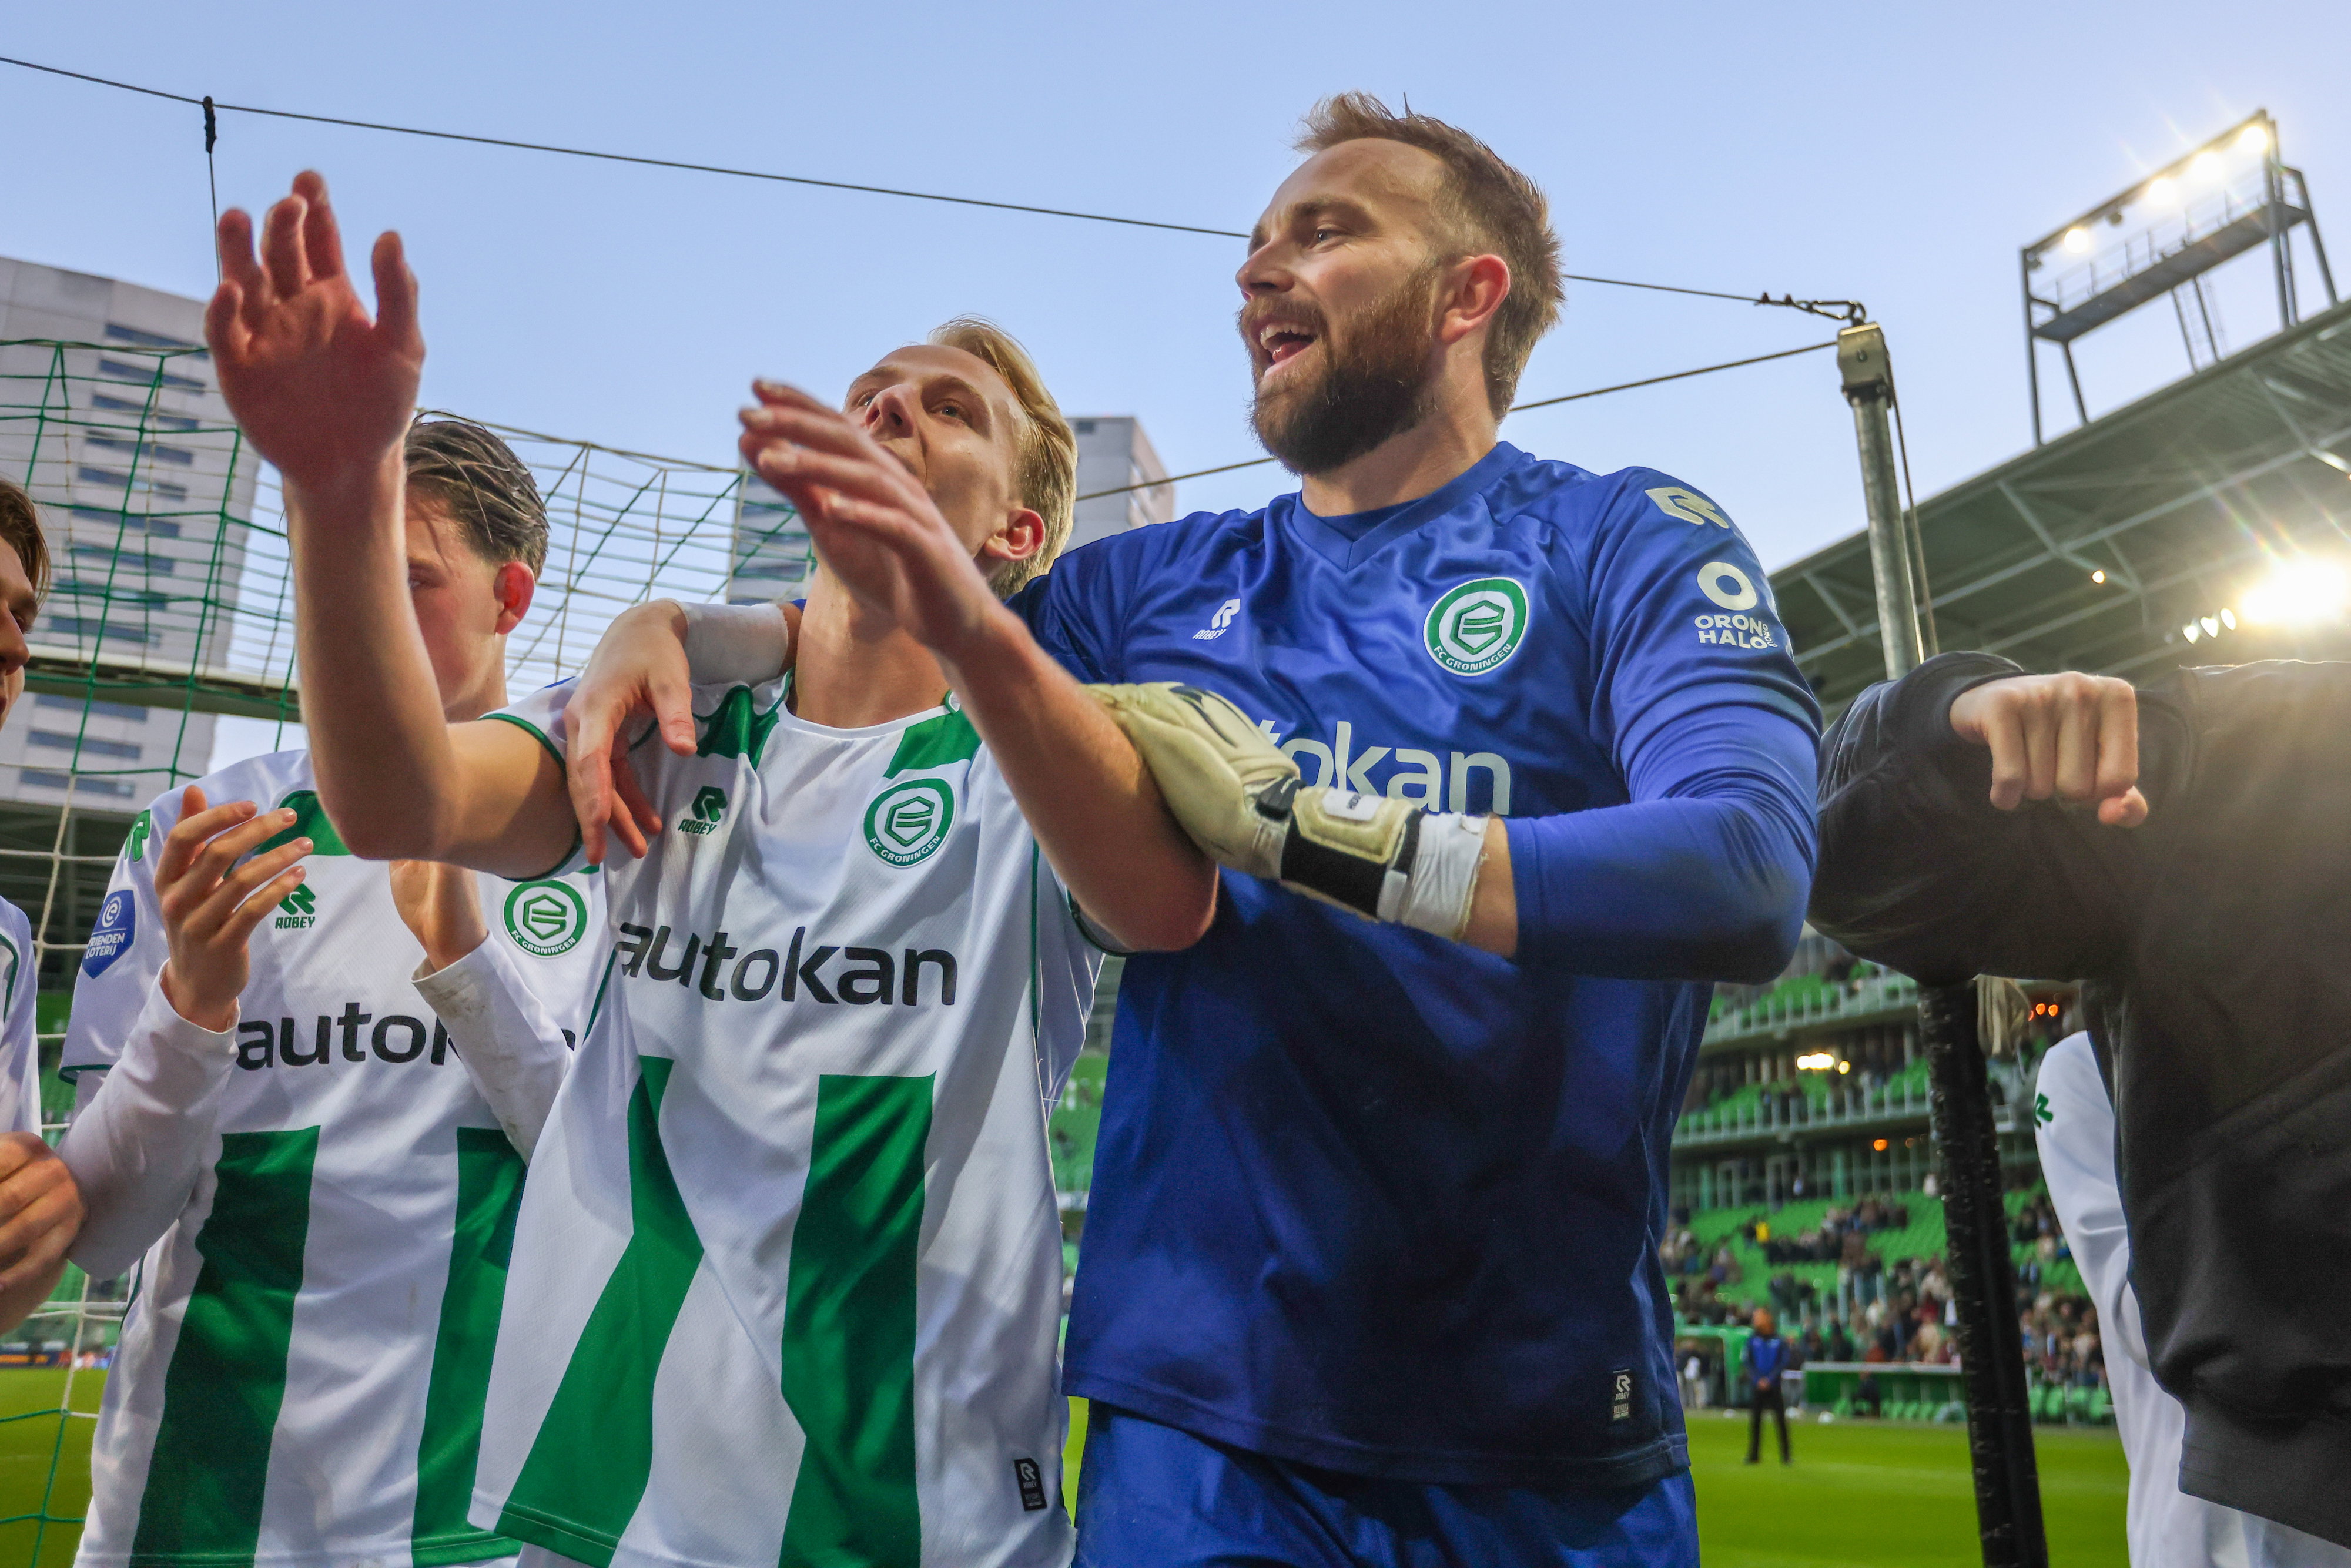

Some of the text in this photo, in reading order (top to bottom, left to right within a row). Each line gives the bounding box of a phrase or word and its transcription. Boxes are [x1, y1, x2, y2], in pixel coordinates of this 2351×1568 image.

[1191, 628, 1227, 641] ROBEY
[1694, 614, 1763, 636] ORON
[1762, 624, 1778, 648] GROUP
[1698, 629, 1768, 649] HALO
[1434, 643, 1512, 671] FC GRONINGEN
[870, 835, 940, 863] FC GRONINGEN
[274, 916, 316, 929] ROBEY
[511, 930, 576, 954] FC GRONINGEN
[617, 922, 957, 1006] autokan
